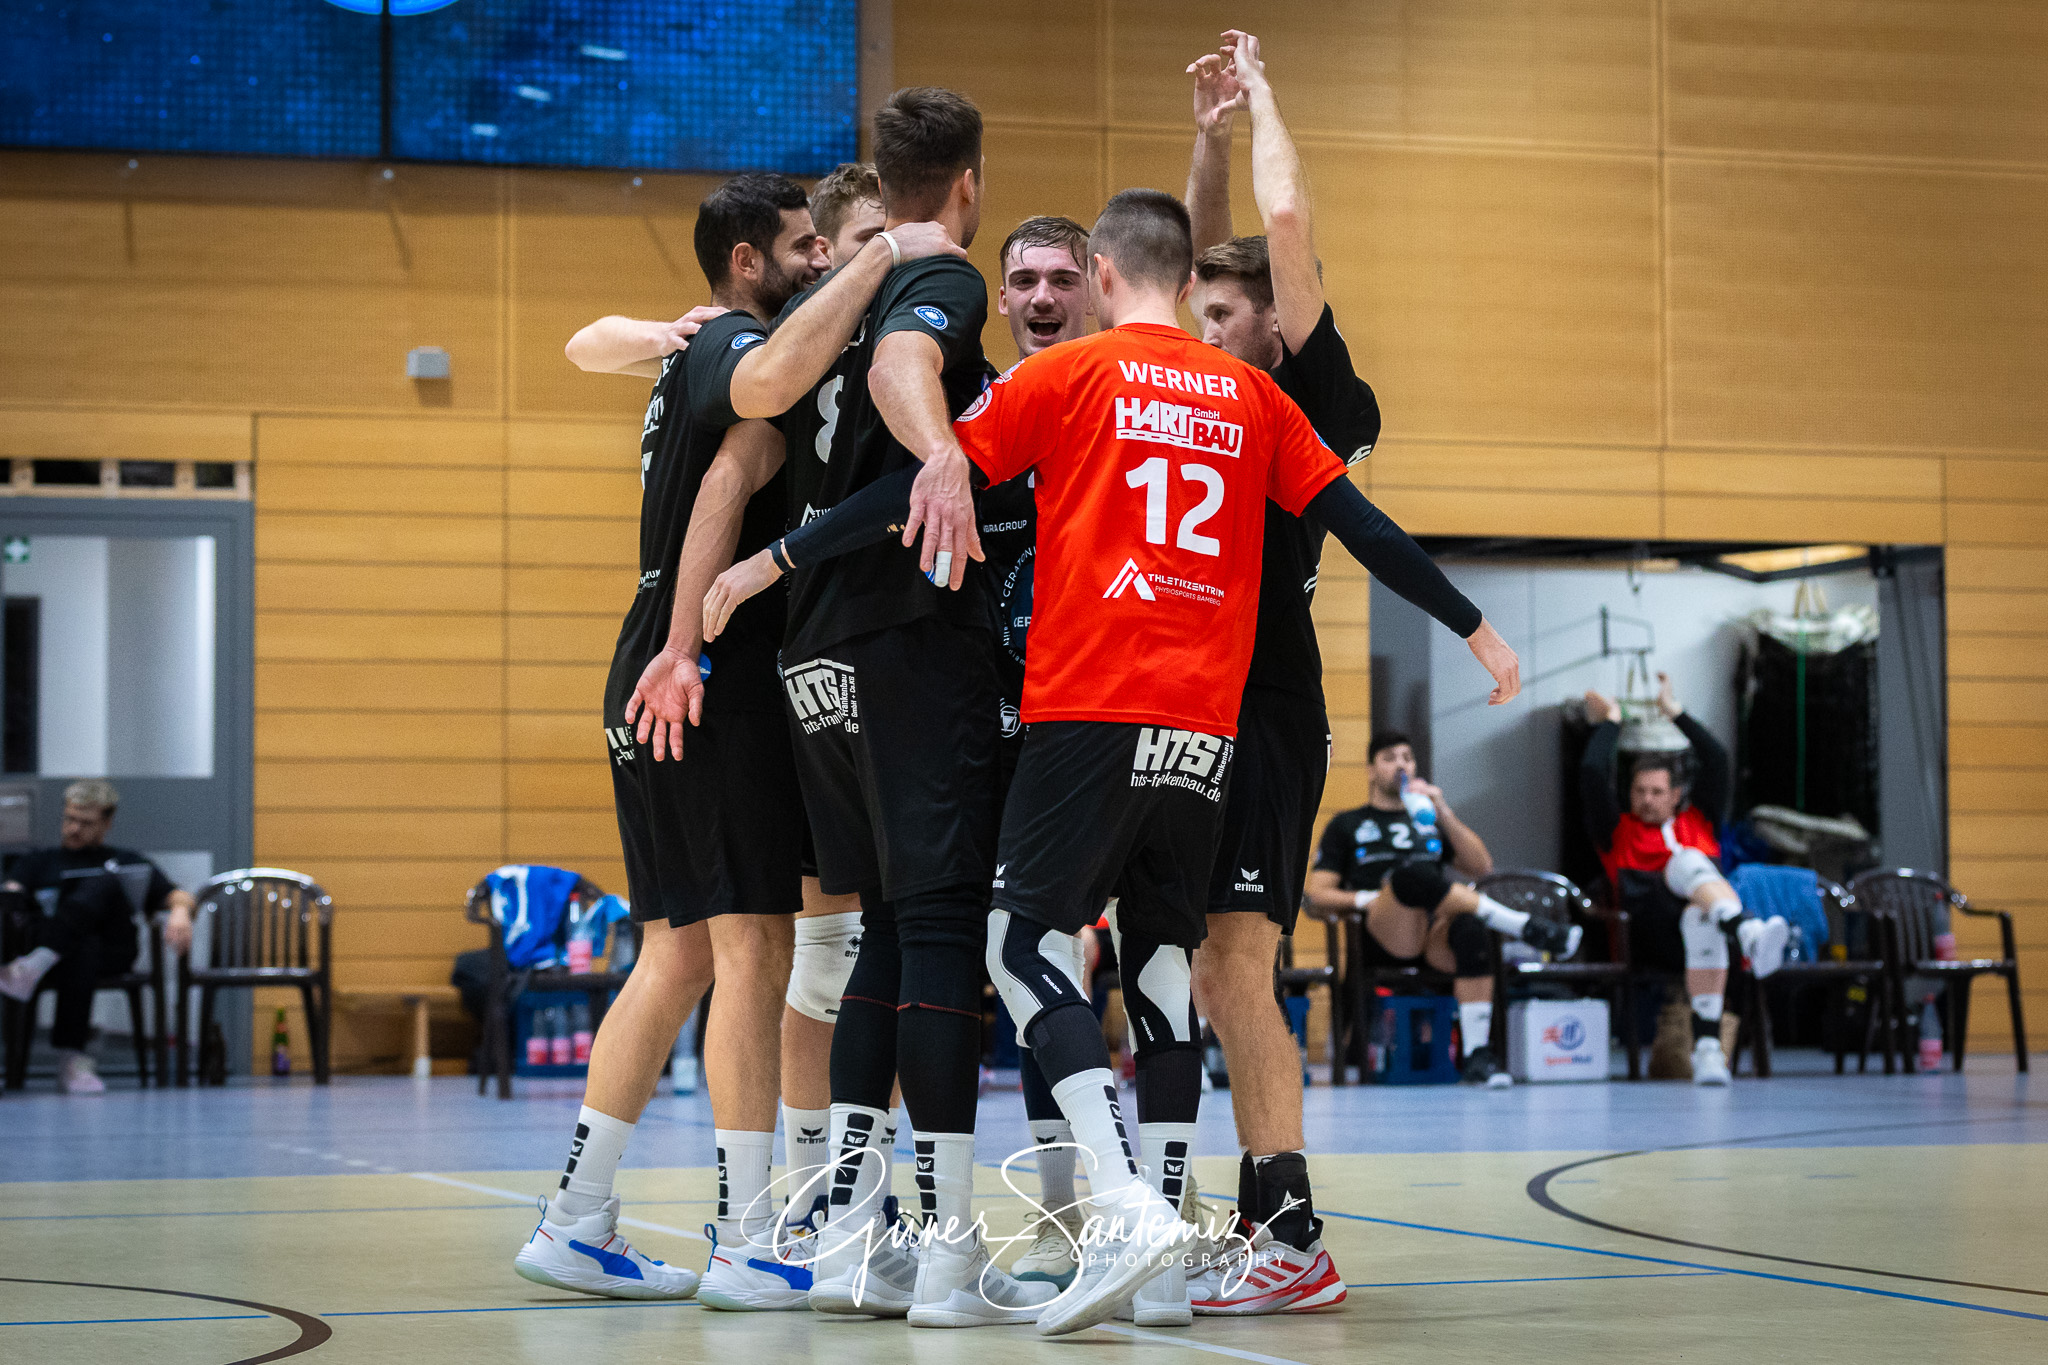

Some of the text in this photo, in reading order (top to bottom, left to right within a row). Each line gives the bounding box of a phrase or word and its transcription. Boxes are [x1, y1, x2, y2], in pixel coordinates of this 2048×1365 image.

[1118, 360, 1239, 400] WERNER
[1115, 397, 1193, 438] HART
[1194, 408, 1220, 420] GmbH
[1193, 421, 1240, 454] BAU
[1125, 456, 1225, 558] 12
[786, 668, 842, 720] HTS
[850, 700, 858, 717] GmbH
[1133, 727, 1222, 778] HTS
[1210, 742, 1230, 785] Frankenbau
[1388, 822, 1414, 850] 2
[1234, 881, 1264, 893] erima
[796, 1136, 827, 1145] erima
